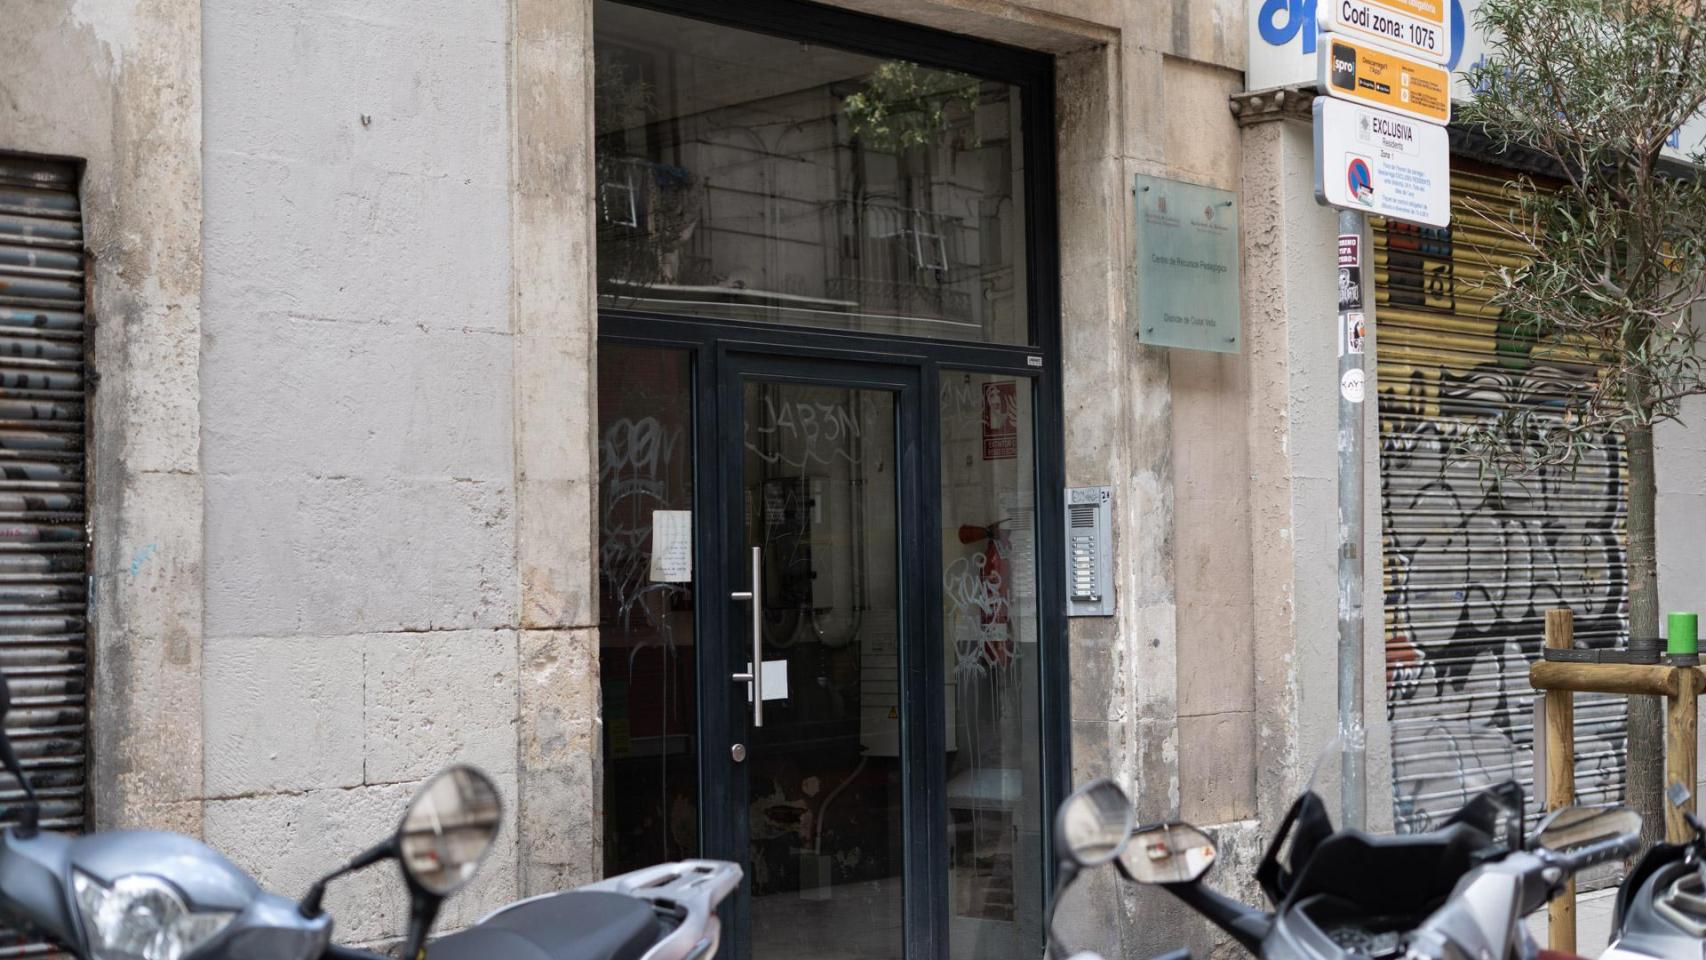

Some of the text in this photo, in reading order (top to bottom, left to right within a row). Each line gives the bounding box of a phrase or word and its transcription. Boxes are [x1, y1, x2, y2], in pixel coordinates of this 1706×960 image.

[1342, 1, 1435, 50] Codi zona: 1075
[1373, 118, 1413, 142] EXCLUSIVA
[1382, 137, 1404, 151] Residents
[1380, 149, 1391, 159] Zona
[1177, 258, 1199, 268] Recursos
